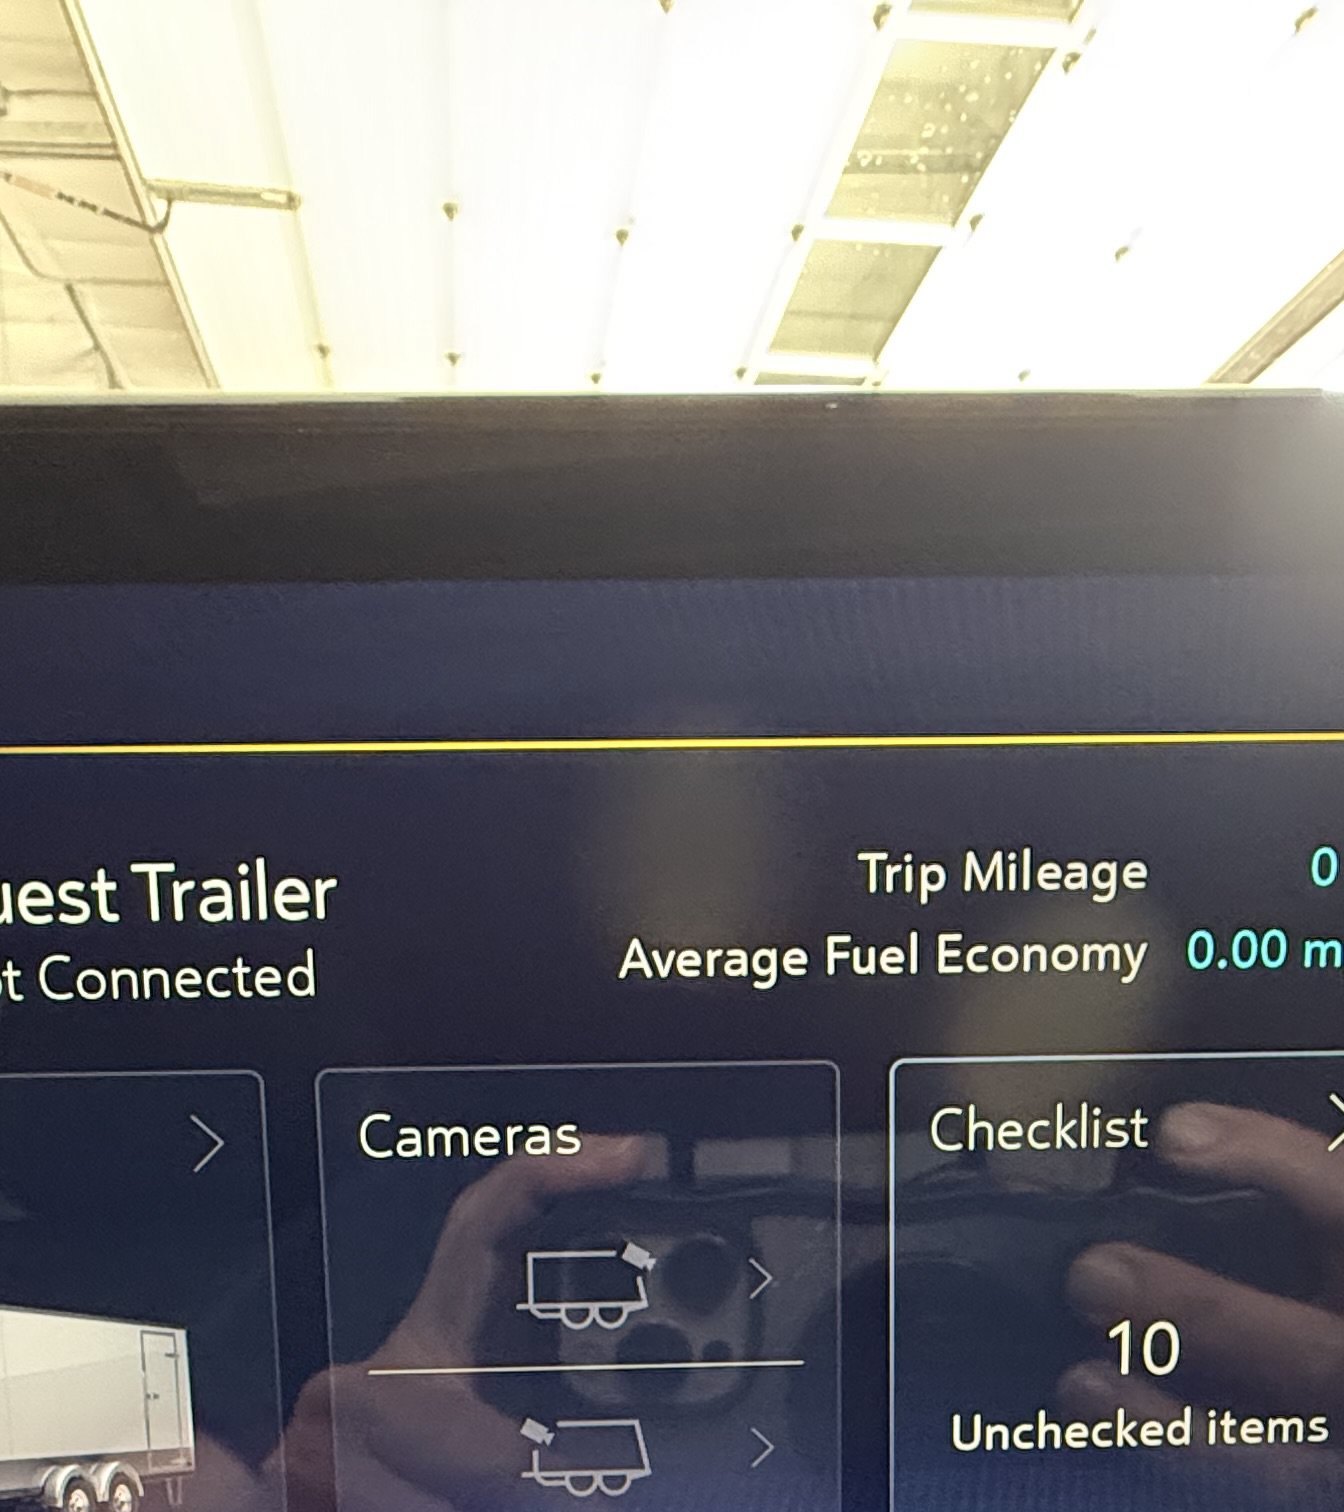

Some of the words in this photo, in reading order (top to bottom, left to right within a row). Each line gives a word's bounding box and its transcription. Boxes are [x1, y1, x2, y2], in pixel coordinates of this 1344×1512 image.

[130, 857, 338, 923] Trailer
[857, 852, 947, 905] Trip
[964, 847, 1148, 903] Mileage
[1311, 846, 1338, 887] 0
[39, 947, 316, 1001] Connected
[618, 937, 808, 990] Average
[826, 931, 918, 976] Fuel
[937, 933, 1148, 984] Economy
[1187, 928, 1287, 970] 0.00
[359, 1113, 582, 1159] Cameras
[931, 1101, 1149, 1152] Checklist
[1108, 1320, 1180, 1376] 10
[952, 1405, 1192, 1451] Unchecked
[1207, 1409, 1329, 1445] items
